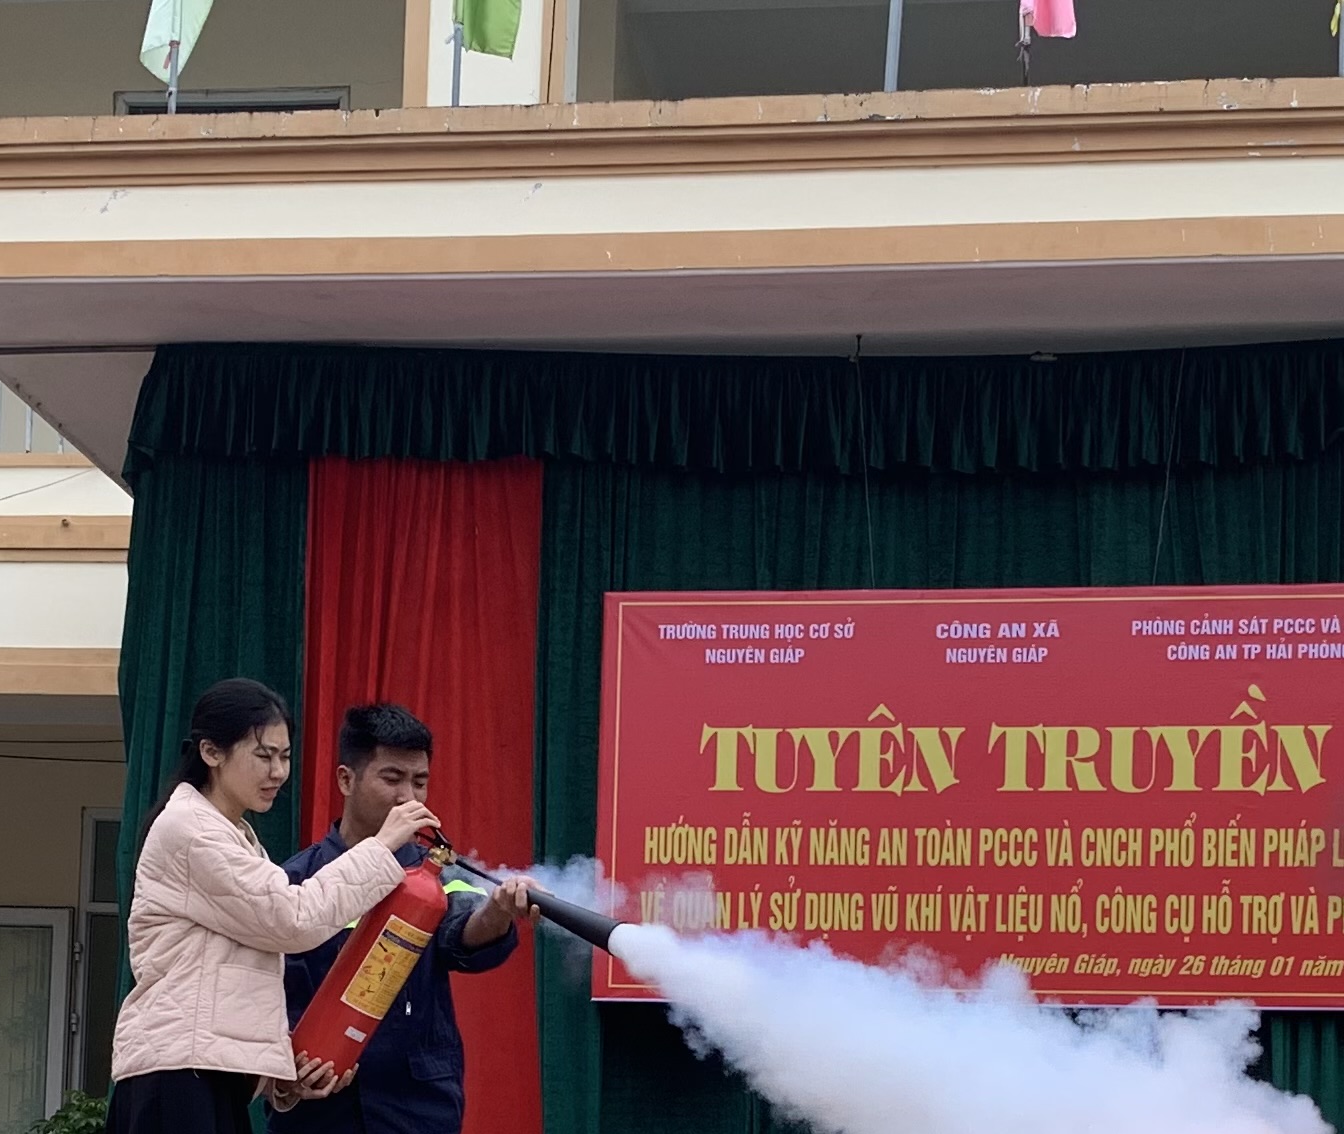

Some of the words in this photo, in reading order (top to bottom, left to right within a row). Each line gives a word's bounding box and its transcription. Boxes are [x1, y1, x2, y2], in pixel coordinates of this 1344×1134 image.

[658, 619, 717, 639] TRƯỜNG
[721, 623, 770, 639] TRUNG
[774, 623, 805, 643] HỌC
[809, 622, 831, 639] CƠ
[834, 617, 856, 639] SỞ
[935, 620, 991, 639] CÔNG
[997, 622, 1027, 638] AN
[1032, 619, 1060, 638] XÃ
[1131, 616, 1185, 636] PHÒNG
[1190, 612, 1234, 635] CẢNH
[1238, 615, 1269, 634] SÁT
[1273, 618, 1316, 634] PCCC
[1320, 615, 1341, 633] VÀ
[705, 645, 765, 664] NGUYÊN
[769, 644, 805, 664] GIÁP
[945, 645, 1008, 664] NGUYÊN
[1012, 644, 1049, 663] GIÁP
[1167, 641, 1210, 660] CÔNG
[1214, 644, 1237, 660] AN
[1242, 644, 1261, 660] TP
[1266, 637, 1293, 659] HẢI
[699, 702, 967, 797] TUYÊN
[987, 683, 1334, 797] TRUYỀN
[644, 815, 717, 866] HƯỚNG
[724, 811, 769, 866] DẪN
[774, 819, 804, 866] KỸ
[808, 818, 871, 866] NĂNG
[876, 827, 908, 867] AN
[914, 819, 973, 867] TOÀN
[978, 827, 1038, 867] PCCC
[1045, 819, 1074, 867] VÀ
[1080, 827, 1143, 867] CNCH
[1149, 811, 1198, 867] PHỔ
[1202, 813, 1256, 867] BIẾN
[1263, 819, 1326, 868] PHÁP
[738, 883, 763, 930] LÝ
[768, 875, 802, 931] SỬ
[804, 891, 865, 940] DỤNG
[871, 885, 899, 932] VŨ
[905, 885, 944, 932] KHÍ
[949, 885, 990, 942] VẬT
[995, 885, 1044, 943] LIỆU
[1050, 878, 1088, 938] NỔ,
[1094, 885, 1158, 934] CÔNG
[1164, 894, 1196, 943] CỤ
[1202, 878, 1234, 934] HỖ
[1240, 892, 1286, 944] TRỢ
[1290, 885, 1320, 935] VÀ
[1073, 953, 1121, 977] Giáp,
[1127, 954, 1177, 978] ngày
[1179, 955, 1207, 976] 26
[1209, 953, 1265, 978] tháng
[1269, 955, 1294, 977] 01
[1299, 955, 1344, 977] năm
